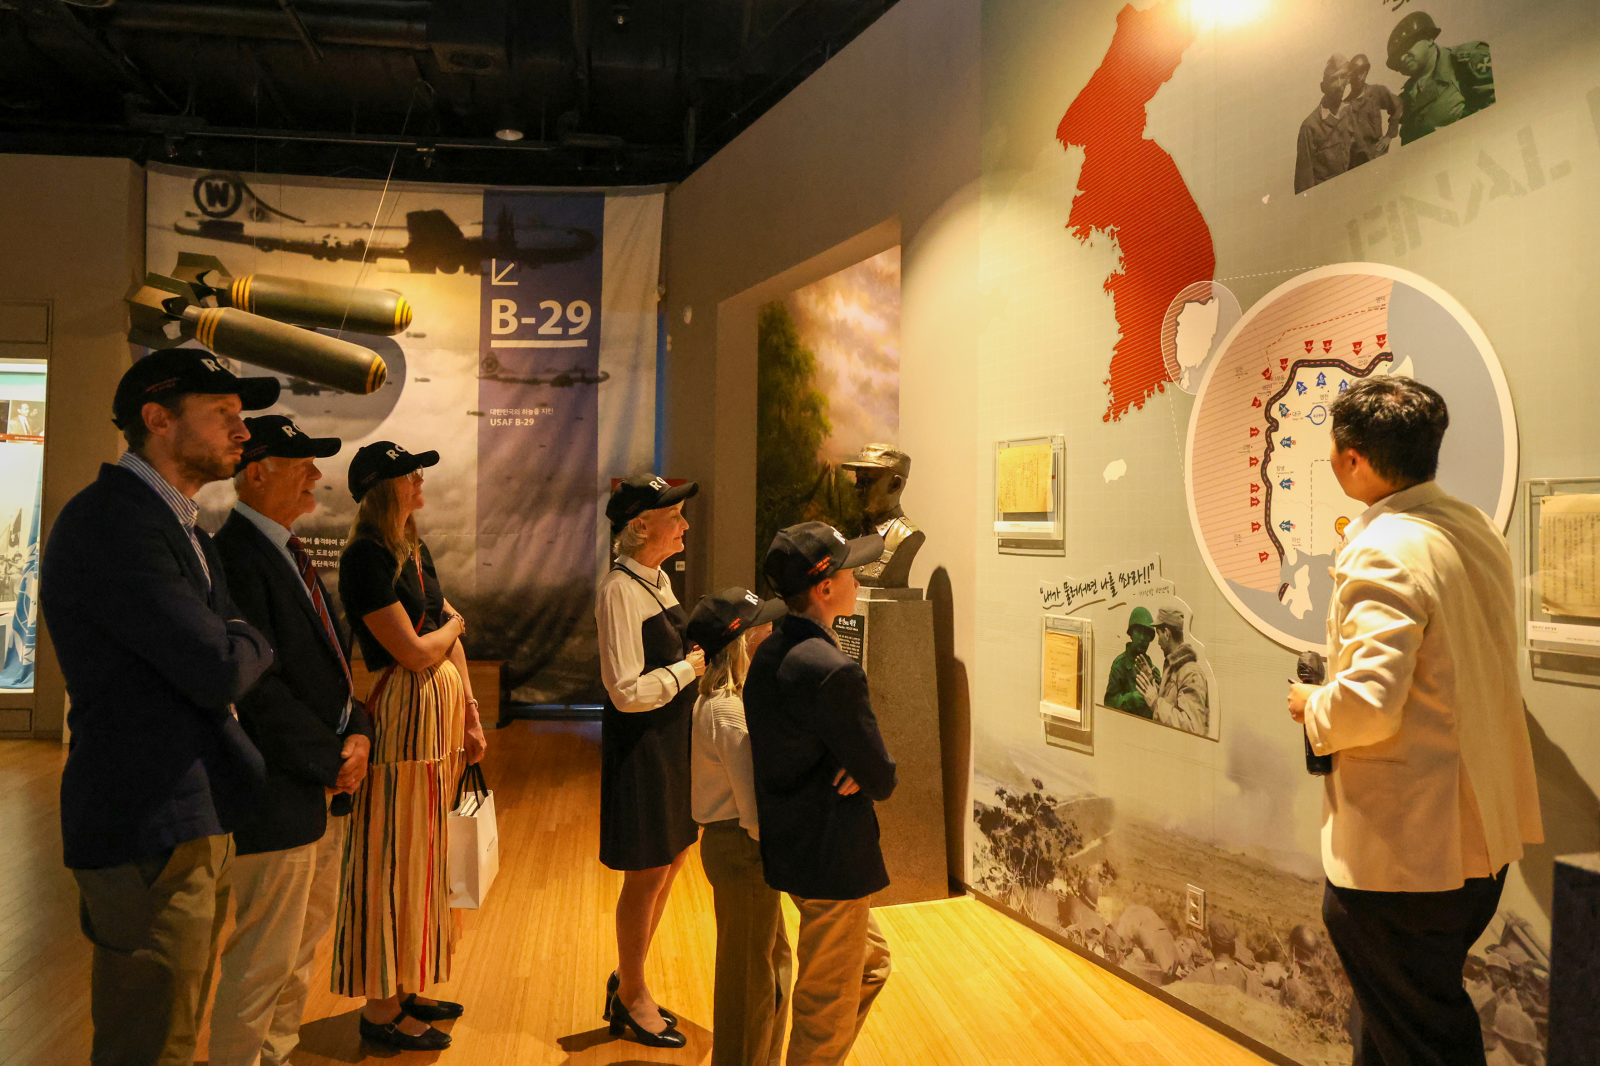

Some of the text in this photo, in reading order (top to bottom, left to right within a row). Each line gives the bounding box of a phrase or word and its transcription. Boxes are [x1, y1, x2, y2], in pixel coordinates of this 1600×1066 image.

[491, 298, 592, 336] B-29
[489, 407, 554, 416] 대한민국의 하늘을 지킨
[489, 418, 535, 427] USAF B-29
[1101, 571, 1118, 598] 나를
